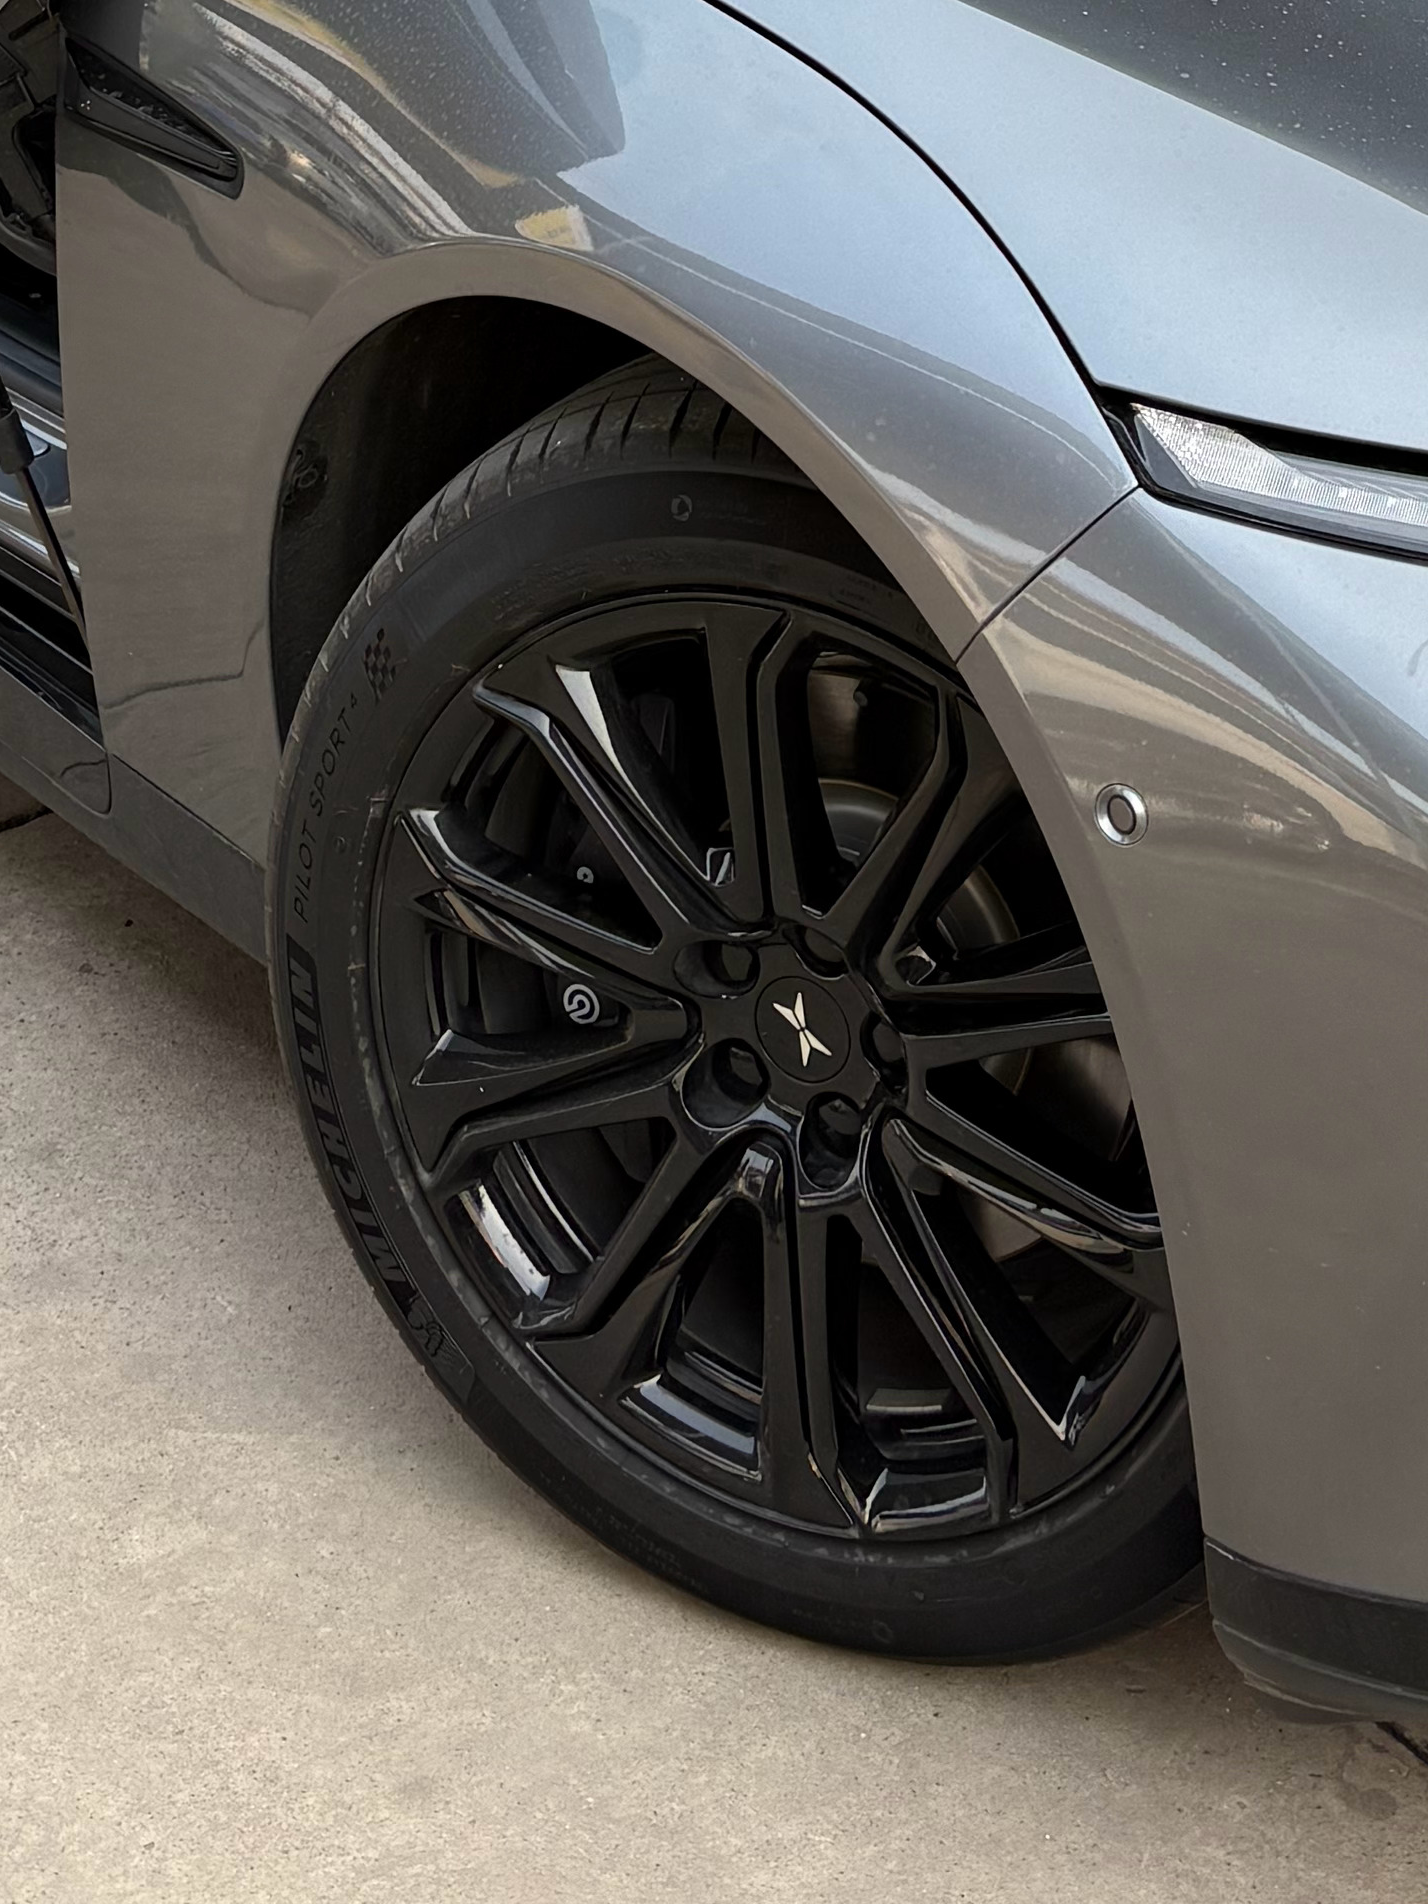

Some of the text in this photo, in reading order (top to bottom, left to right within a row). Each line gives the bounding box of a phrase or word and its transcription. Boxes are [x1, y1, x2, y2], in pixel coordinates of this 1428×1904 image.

[293, 819, 317, 924] PILOT
[309, 707, 352, 817] SPORT
[288, 961, 407, 1284] MICHELIN
